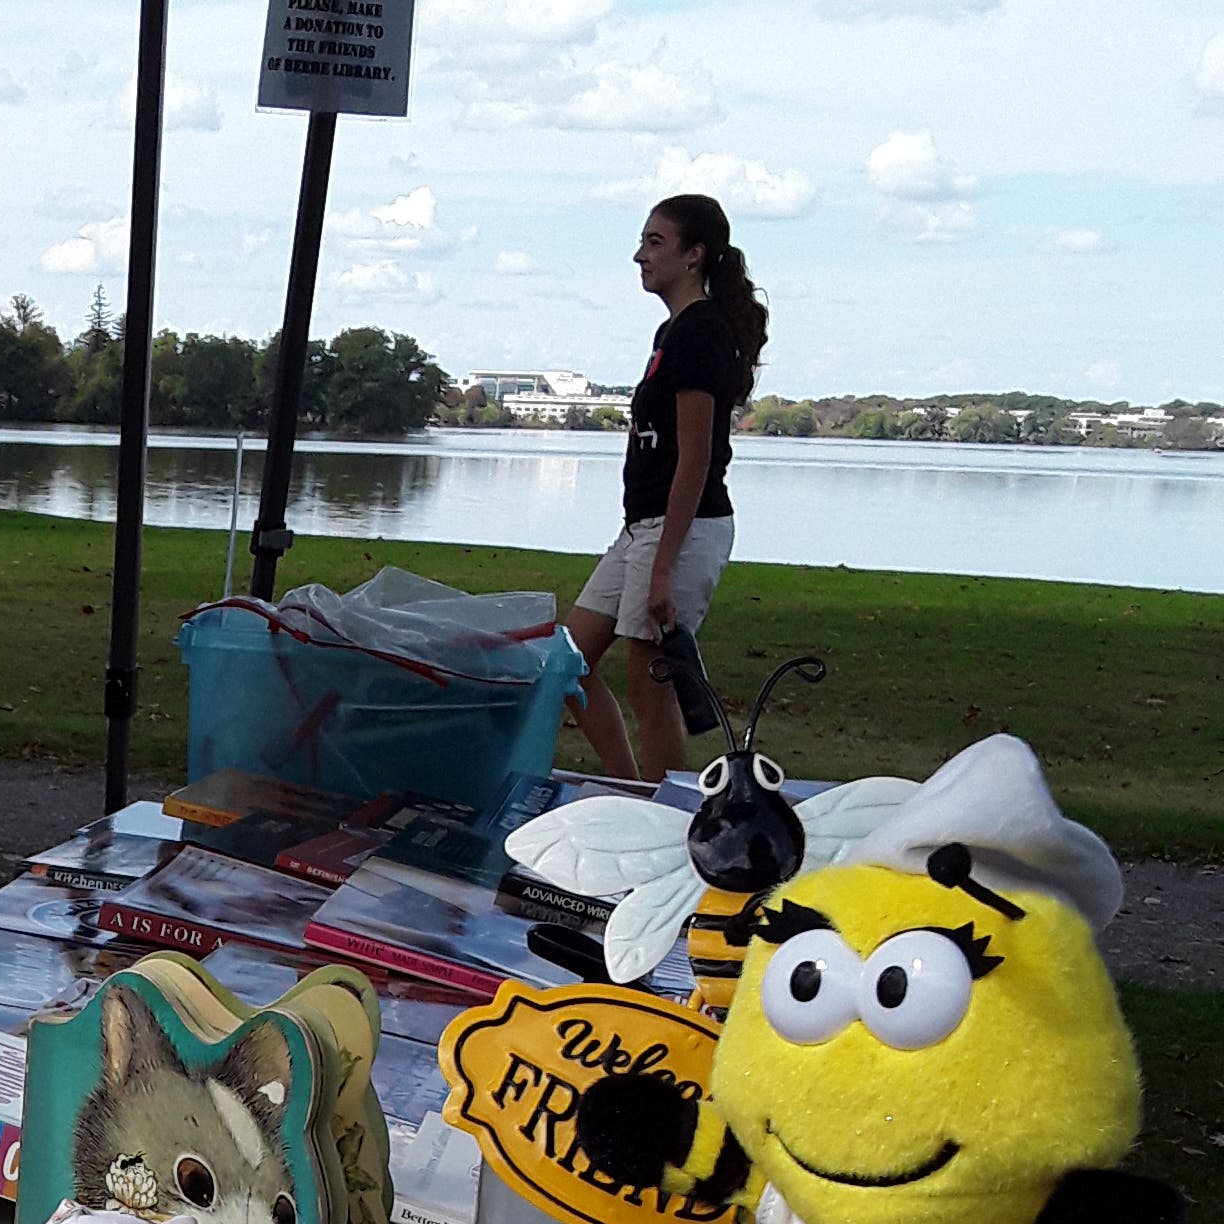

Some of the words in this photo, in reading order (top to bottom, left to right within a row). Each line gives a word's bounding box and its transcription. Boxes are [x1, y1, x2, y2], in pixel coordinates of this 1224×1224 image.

[347, 2, 383, 17] MAKE
[284, 16, 292, 31] A
[295, 17, 364, 37] DONATION
[366, 24, 384, 39] TO
[287, 38, 316, 53] THE
[318, 40, 376, 58] FRIENDS
[267, 57, 282, 71] OF
[284, 59, 330, 75] BEEBE
[54, 871, 104, 891] Kitchen
[522, 886, 586, 913] ADVANCED
[110, 912, 124, 929] A
[131, 916, 152, 934] IS
[159, 922, 203, 946] FOR
